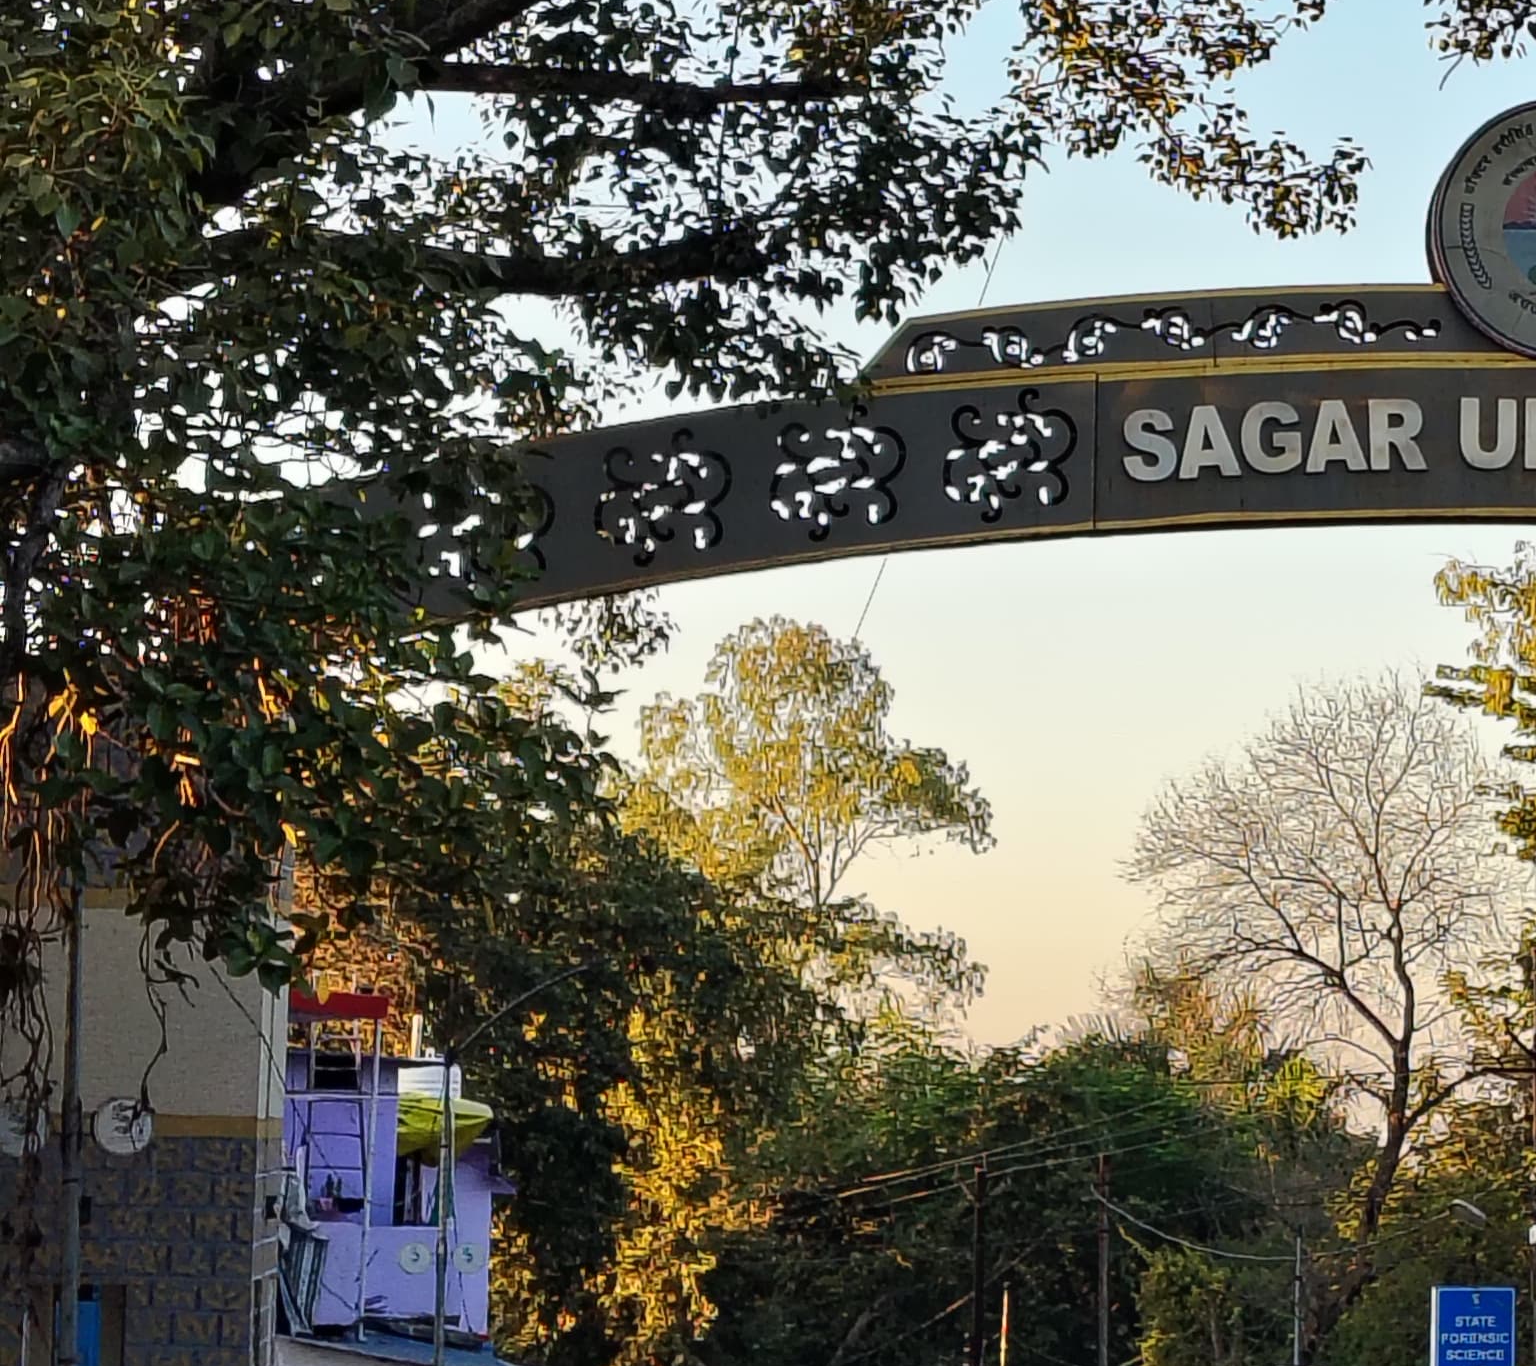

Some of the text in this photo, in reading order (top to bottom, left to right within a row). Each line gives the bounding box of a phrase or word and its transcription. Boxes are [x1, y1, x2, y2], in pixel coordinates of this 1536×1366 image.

[1122, 398, 1429, 482] SAGAR
[1455, 1316, 1496, 1327] STATE
[1441, 1332, 1509, 1345] FORENSIC
[1446, 1349, 1504, 1361] SCIENCE
